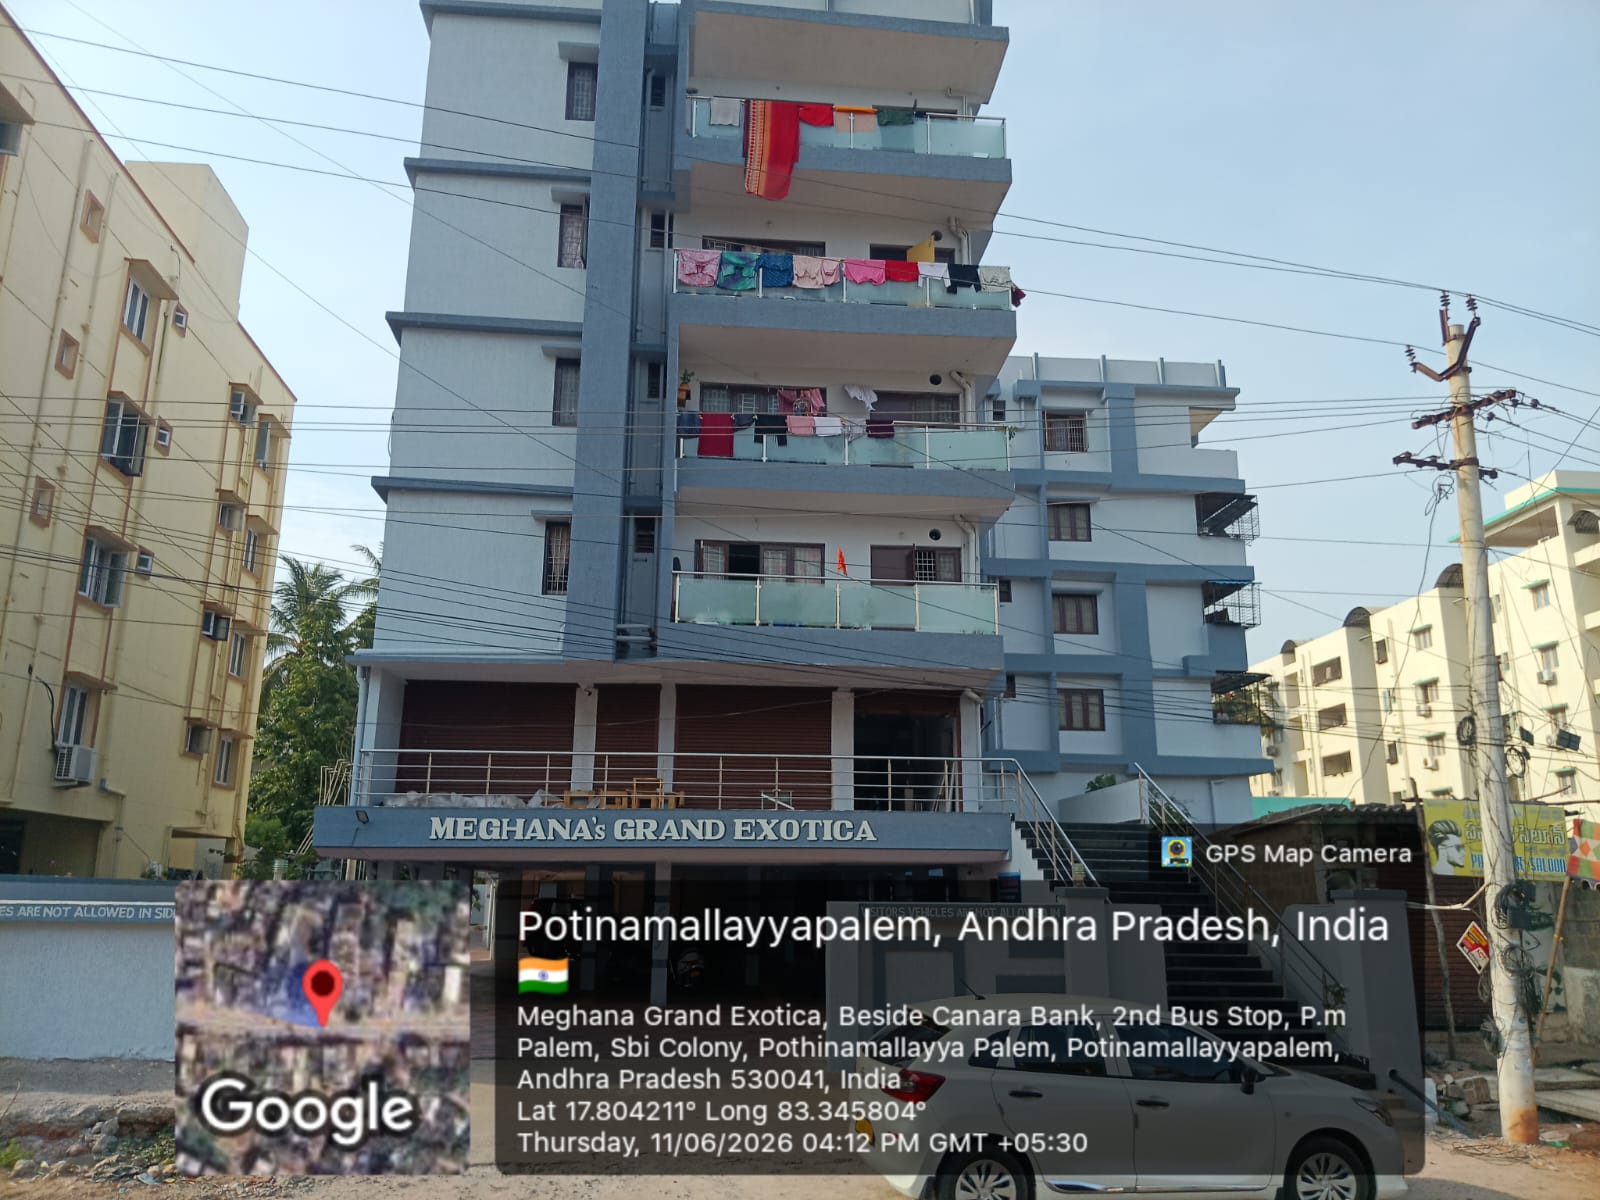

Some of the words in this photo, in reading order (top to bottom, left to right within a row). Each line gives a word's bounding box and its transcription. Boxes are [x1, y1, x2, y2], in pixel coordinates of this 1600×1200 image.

[429, 816, 605, 841] MEGHANA's
[613, 818, 725, 841] GRAND
[733, 818, 877, 842] EXOTICA
[1530, 857, 1567, 873] SALOON
[0, 906, 13, 917] ES
[17, 906, 41, 917] ARE
[43, 906, 72, 918] NOT
[74, 907, 135, 919] ALLOWED
[138, 908, 152, 919] IN
[154, 908, 175, 920] SID
[861, 907, 905, 918] VSITORS
